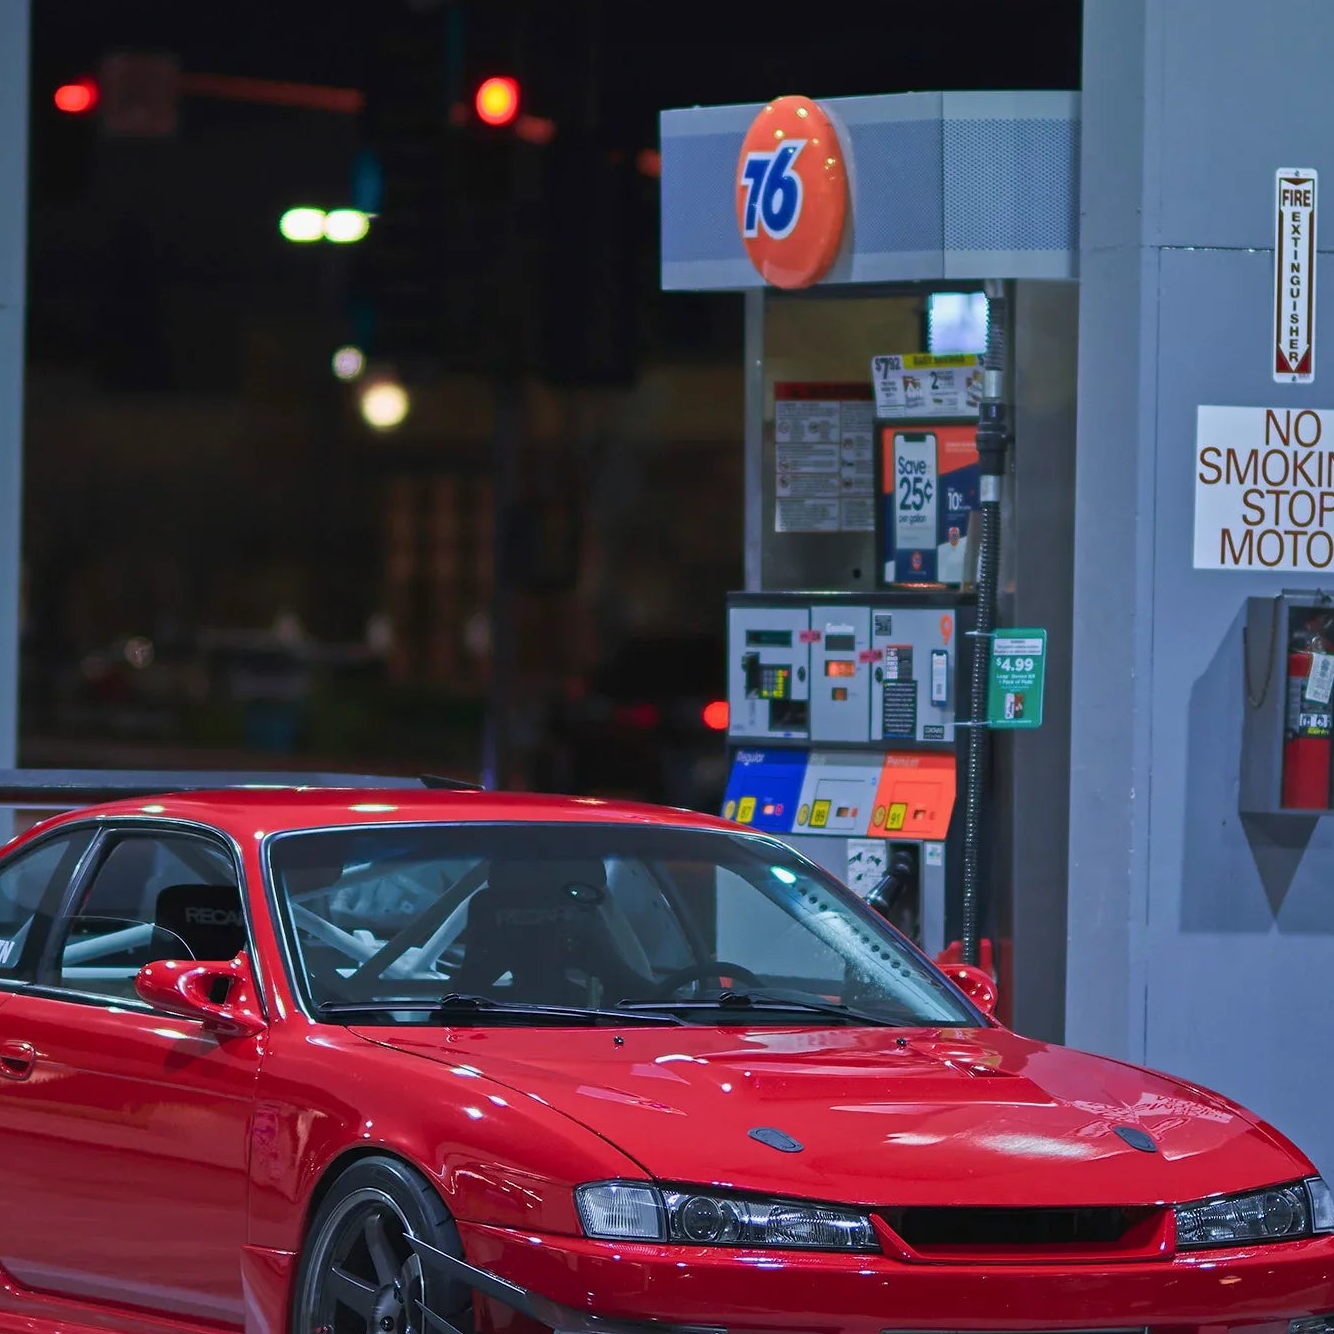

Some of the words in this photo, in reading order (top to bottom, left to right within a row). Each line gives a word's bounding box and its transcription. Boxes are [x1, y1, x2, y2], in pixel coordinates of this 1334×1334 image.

[741, 139, 807, 239] 76
[1282, 189, 1311, 208] FIRE
[1288, 211, 1302, 363] EXTINGUISHER
[1265, 409, 1323, 448] NO
[898, 455, 927, 475] Save
[899, 476, 933, 511] 25¢
[996, 657, 1035, 672] $4.99
[185, 907, 244, 927] RECA
